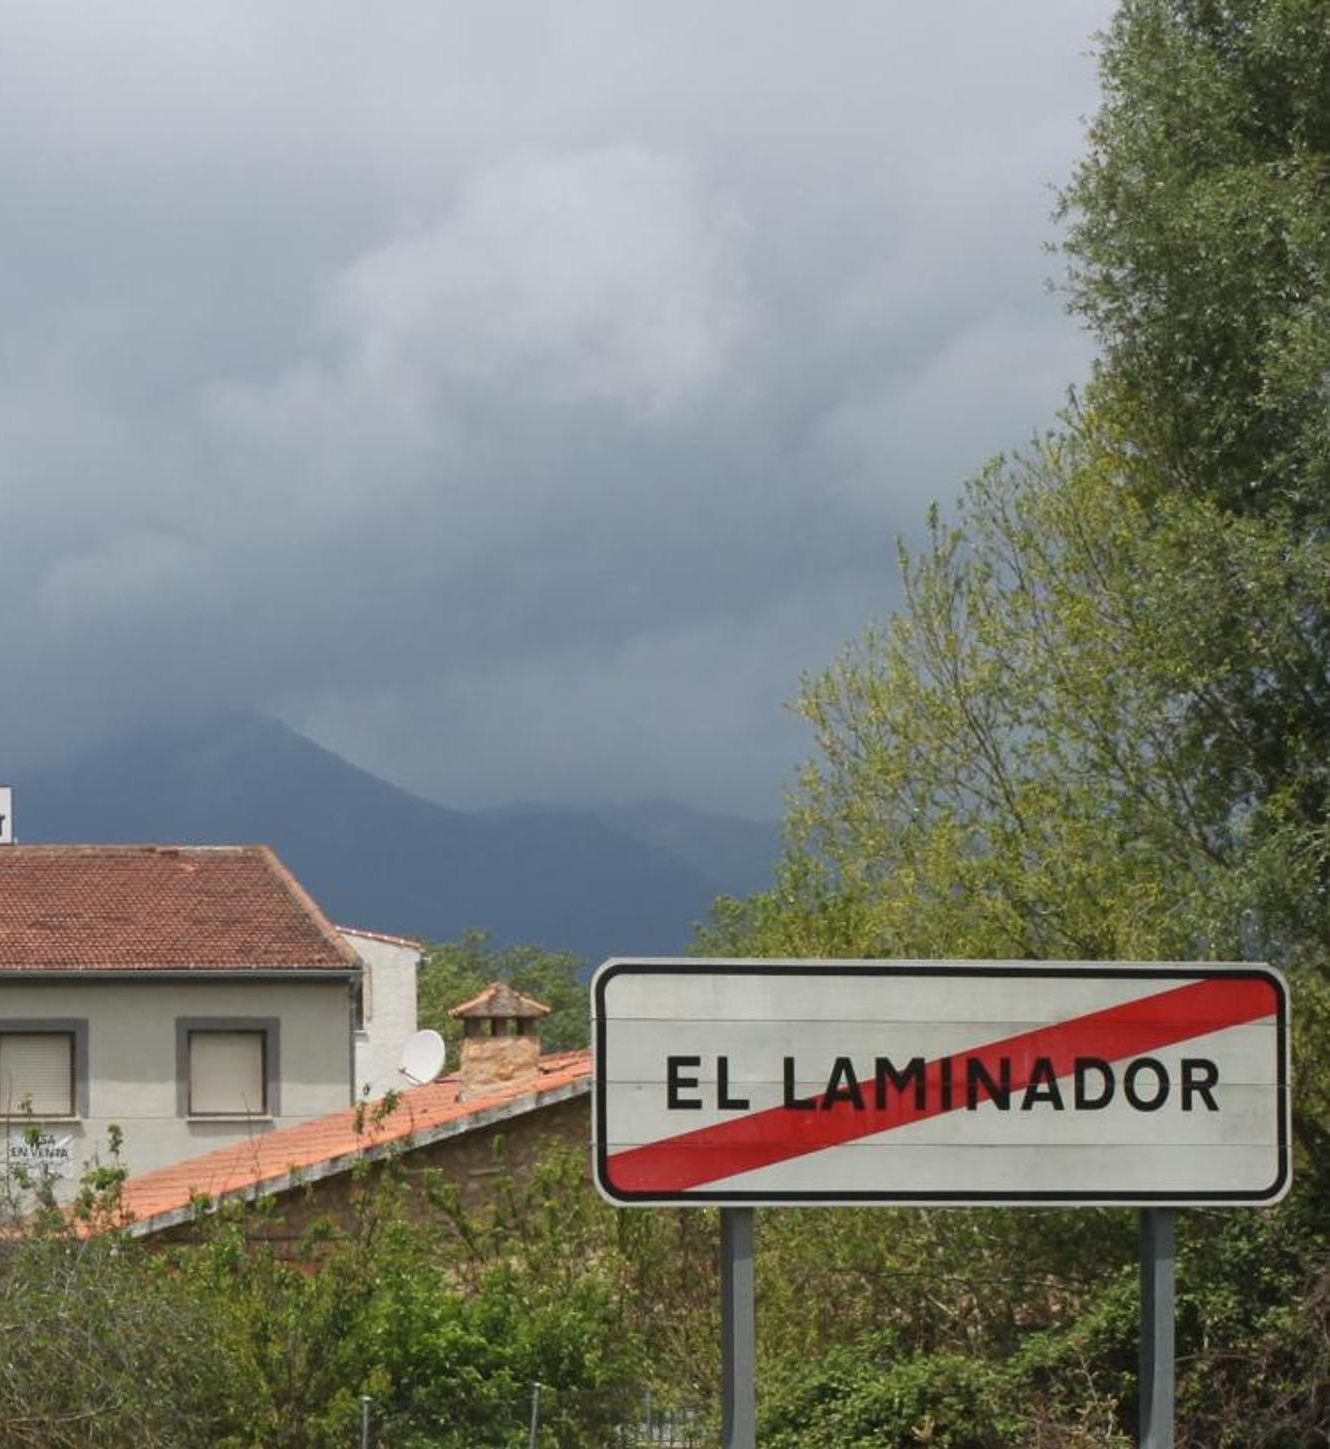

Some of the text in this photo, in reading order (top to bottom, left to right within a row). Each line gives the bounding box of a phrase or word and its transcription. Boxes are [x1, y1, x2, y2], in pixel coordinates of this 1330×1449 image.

[666, 1055, 1221, 1113] EL LAMINADOR
[11, 1147, 28, 1157] EN
